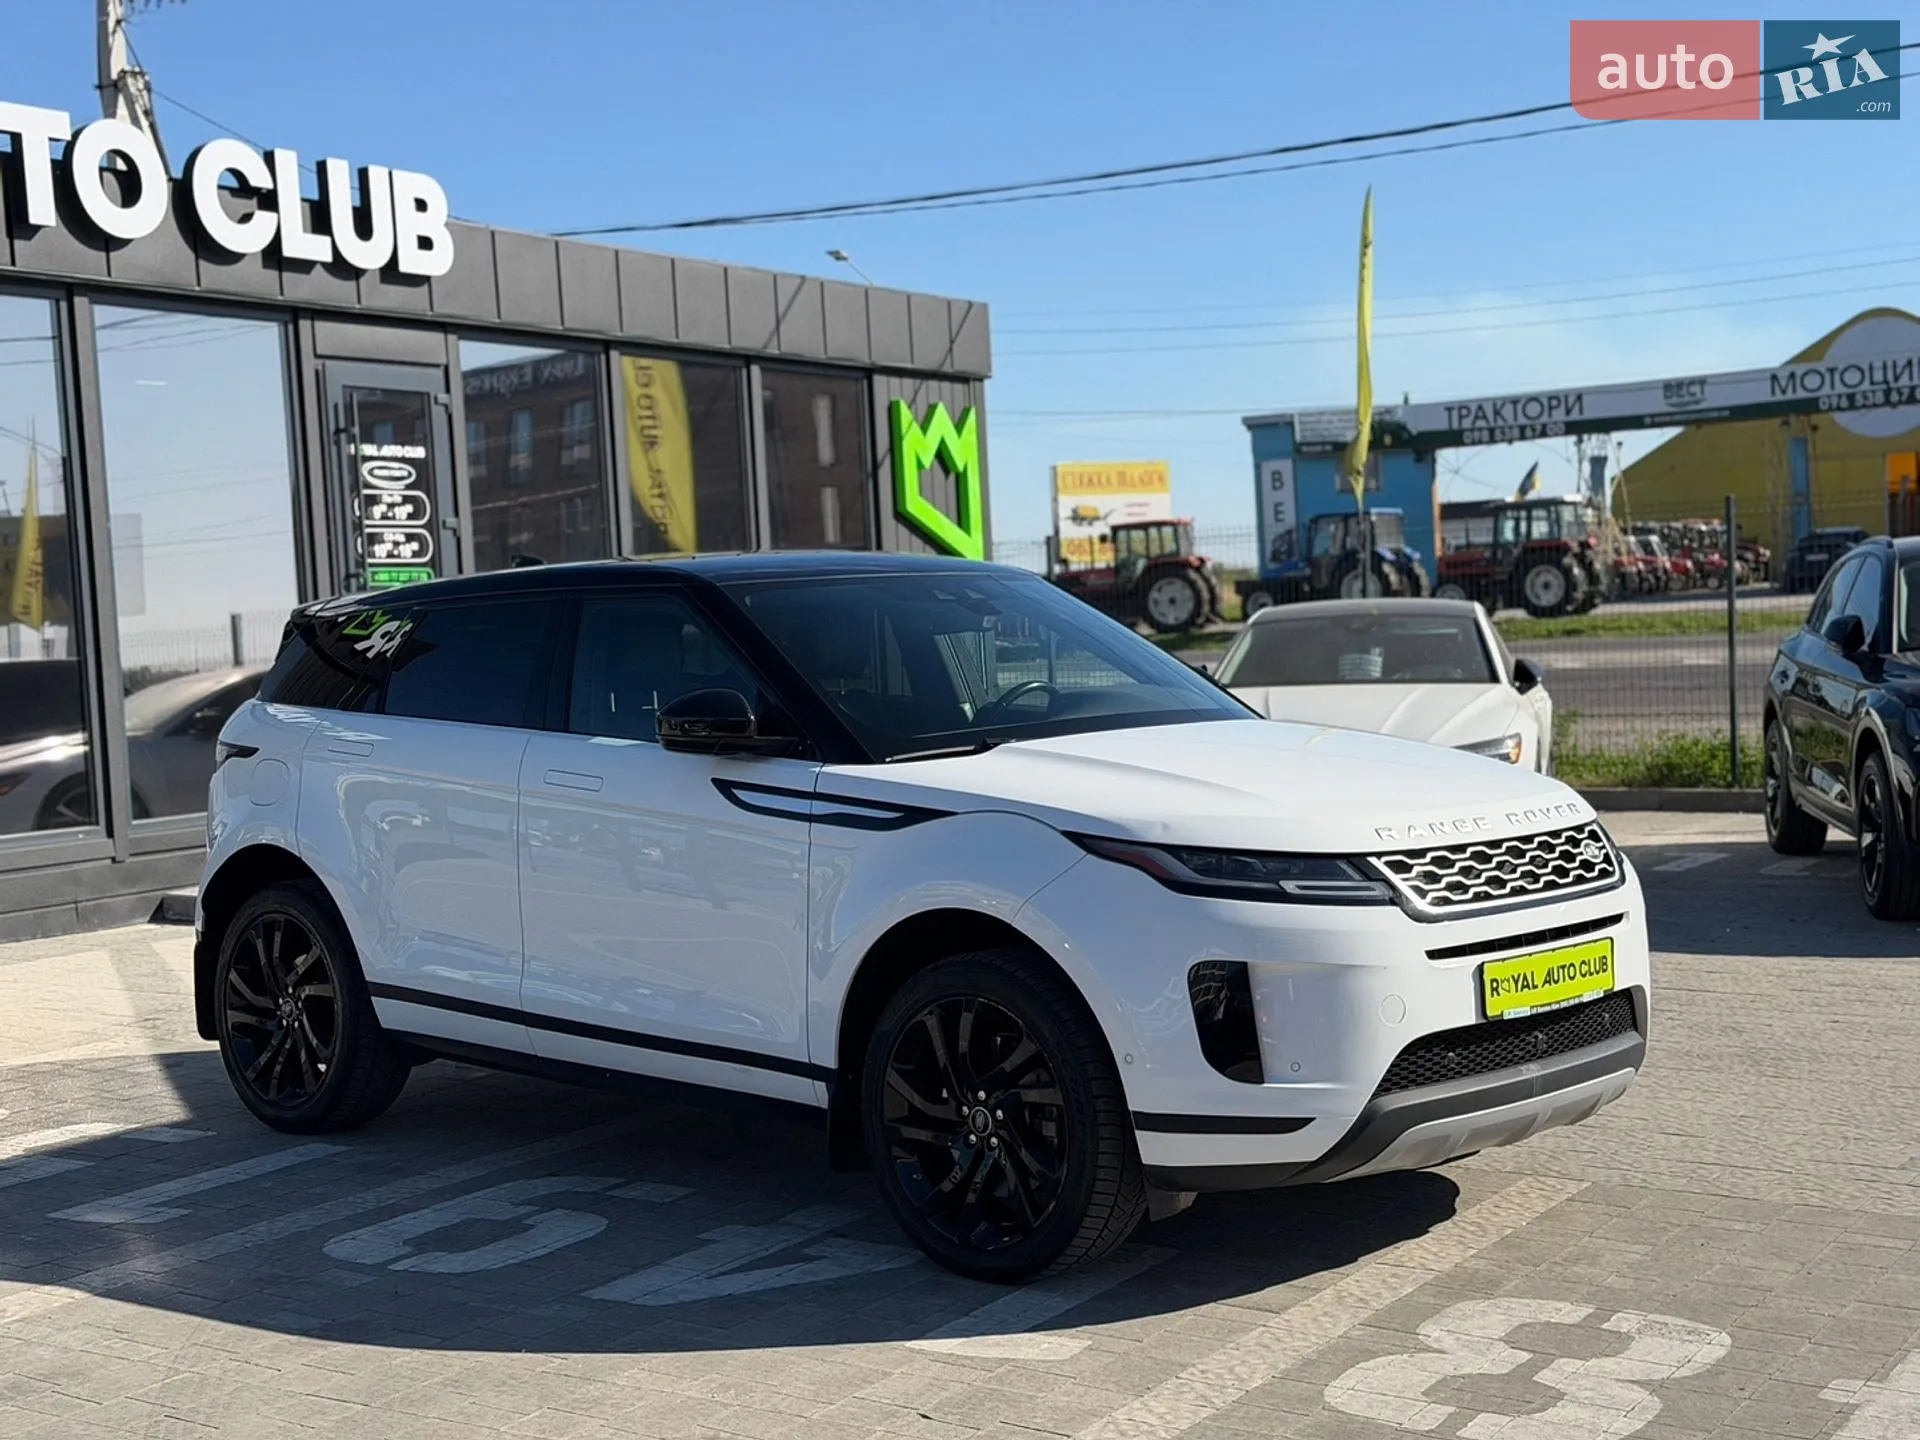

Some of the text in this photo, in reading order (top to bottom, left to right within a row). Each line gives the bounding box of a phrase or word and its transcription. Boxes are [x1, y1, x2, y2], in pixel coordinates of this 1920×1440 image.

[192, 137, 455, 278] CLUB
[1769, 356, 1920, 396] МОТОЦИ
[1444, 393, 1584, 429] ТРАКТОРИ
[1374, 802, 1581, 842] RANGE ROVER
[1541, 962, 1577, 988] AUTO
[1579, 955, 1609, 979] CLUB
